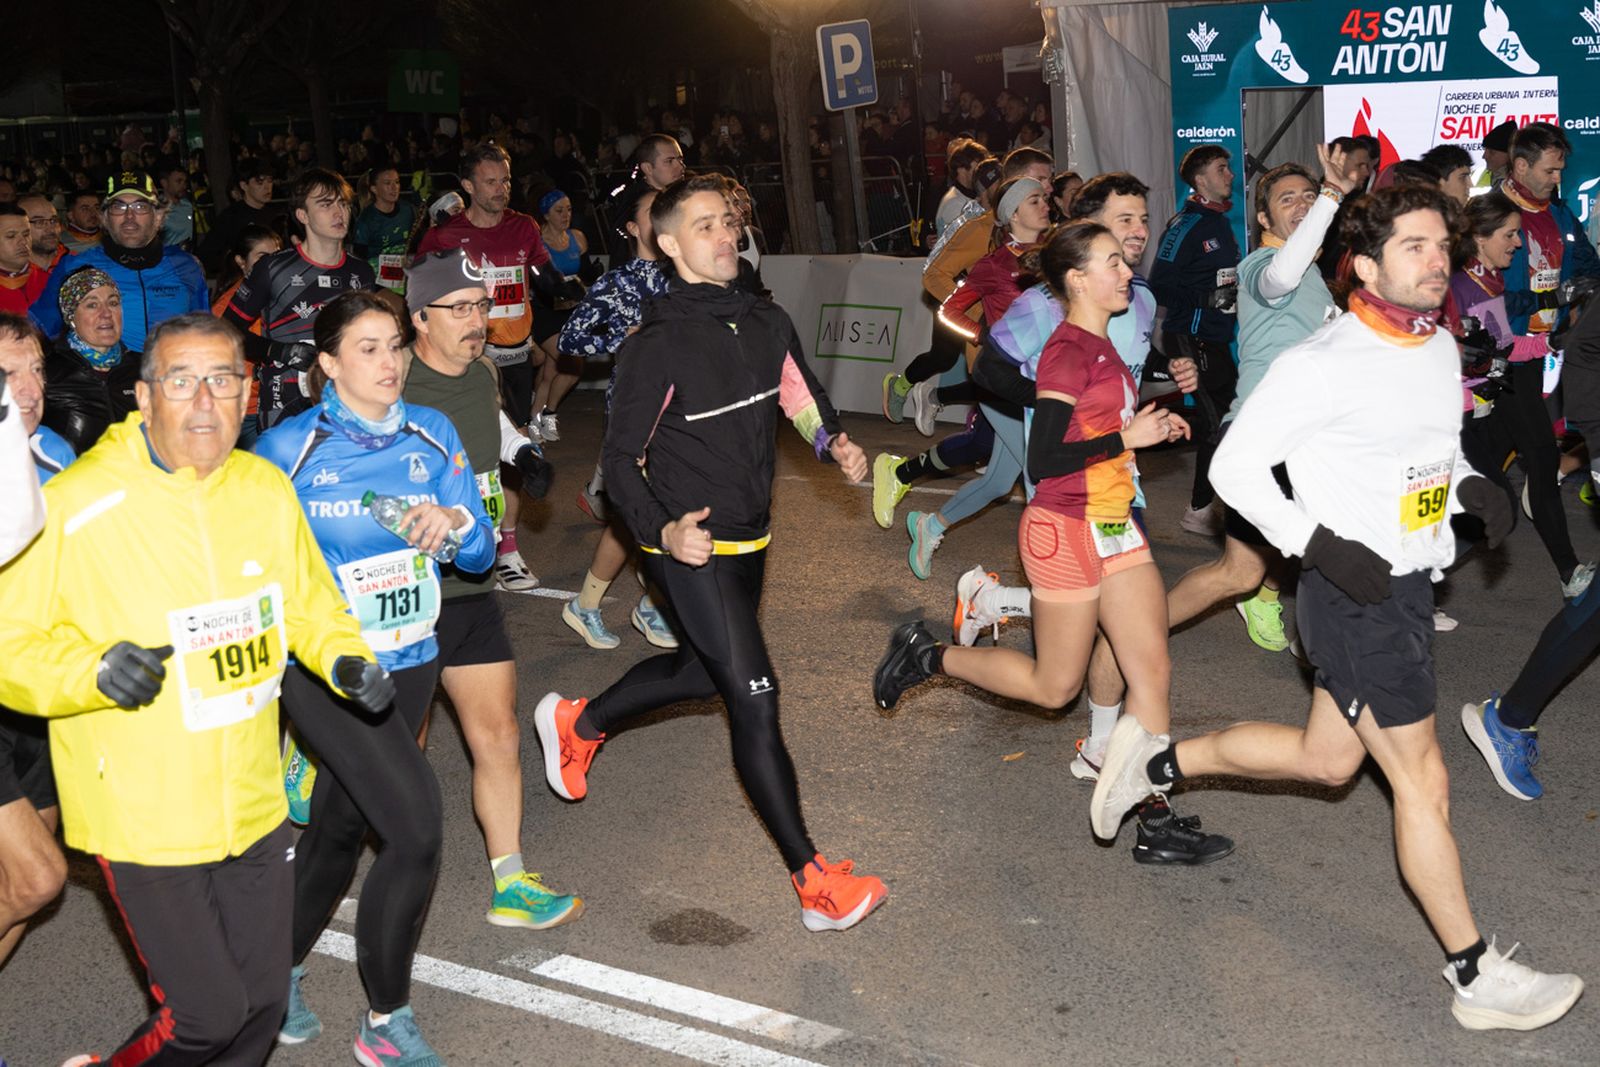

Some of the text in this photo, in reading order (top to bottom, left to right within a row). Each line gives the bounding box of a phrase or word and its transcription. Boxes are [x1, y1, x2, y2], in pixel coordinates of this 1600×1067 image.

[1340, 4, 1452, 42] 43 SAN
[1497, 38, 1519, 61] 43
[1572, 36, 1595, 45] CAJA
[1181, 53, 1226, 63] CAJA RURAL
[1271, 49, 1291, 71] 43
[1331, 33, 1448, 75] ANTÓN
[831, 32, 863, 100] P
[405, 69, 445, 95] WC
[1445, 89, 1558, 101] CARRERA URBANA INTERN
[1443, 103, 1497, 114] NOCHE DE
[1177, 125, 1236, 138] calderón
[1440, 115, 1495, 140] SAN
[366, 562, 407, 579] NOCHE DE
[358, 575, 409, 594] SAN ANTON
[375, 584, 419, 621] 7131
[203, 609, 253, 630] NOCHE DE
[190, 625, 255, 650] SAN ANTON
[209, 634, 270, 682] 1914
